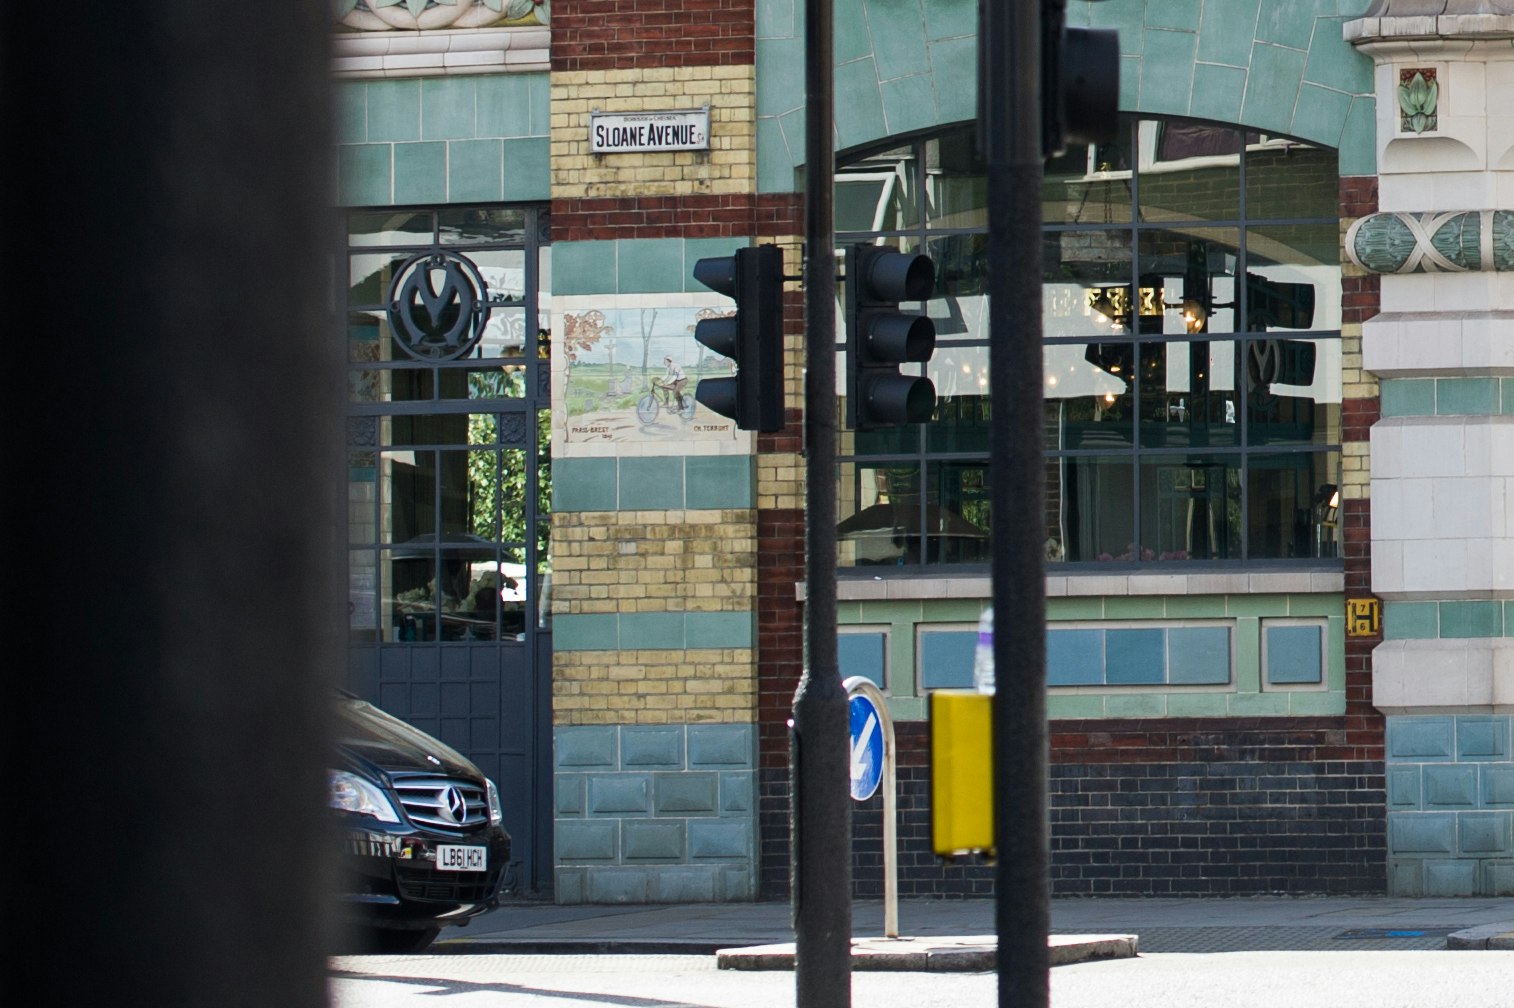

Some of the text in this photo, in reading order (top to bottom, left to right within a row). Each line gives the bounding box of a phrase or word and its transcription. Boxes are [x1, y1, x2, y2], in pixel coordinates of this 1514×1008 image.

[596, 124, 645, 147] SLOANE
[647, 123, 696, 146] AVENUE
[1360, 604, 1366, 613] 7
[1352, 602, 1375, 633] H
[1360, 622, 1366, 631] 6
